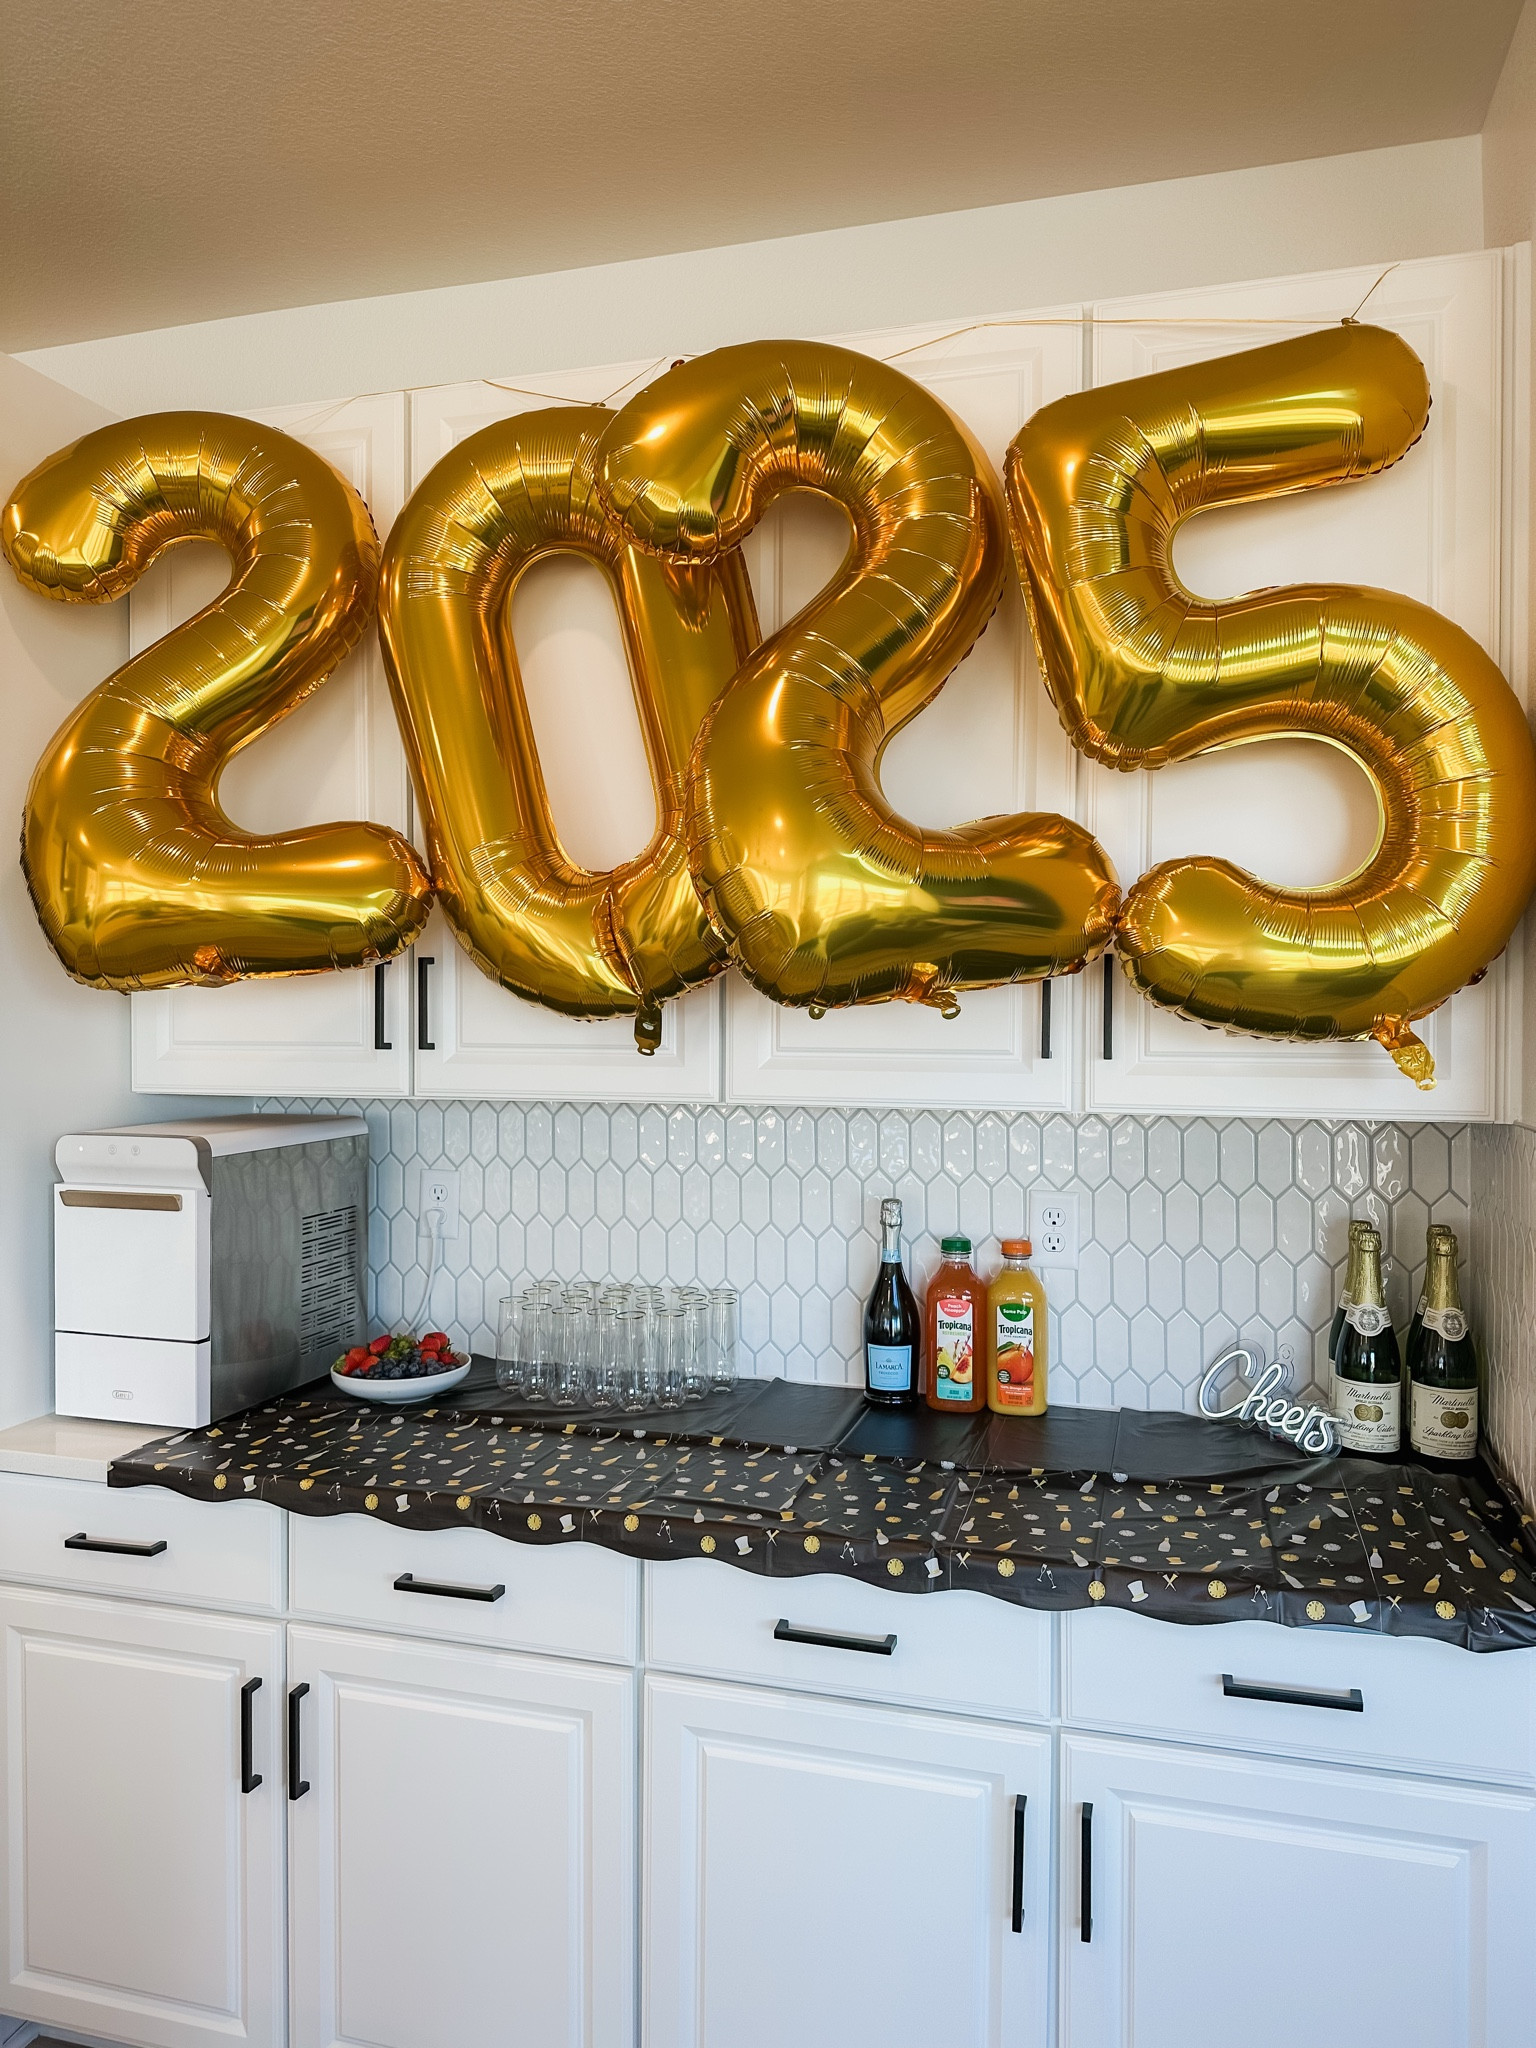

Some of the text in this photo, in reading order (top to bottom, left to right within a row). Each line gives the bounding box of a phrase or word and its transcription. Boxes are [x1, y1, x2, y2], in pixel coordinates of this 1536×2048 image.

[2, 322, 1536, 1044] 2025
[938, 1320, 971, 1331] Tropicana
[998, 1325, 1032, 1335] Tropicana
[1199, 1349, 1343, 1452] Cheers
[1422, 1426, 1462, 1440] Sparkling
